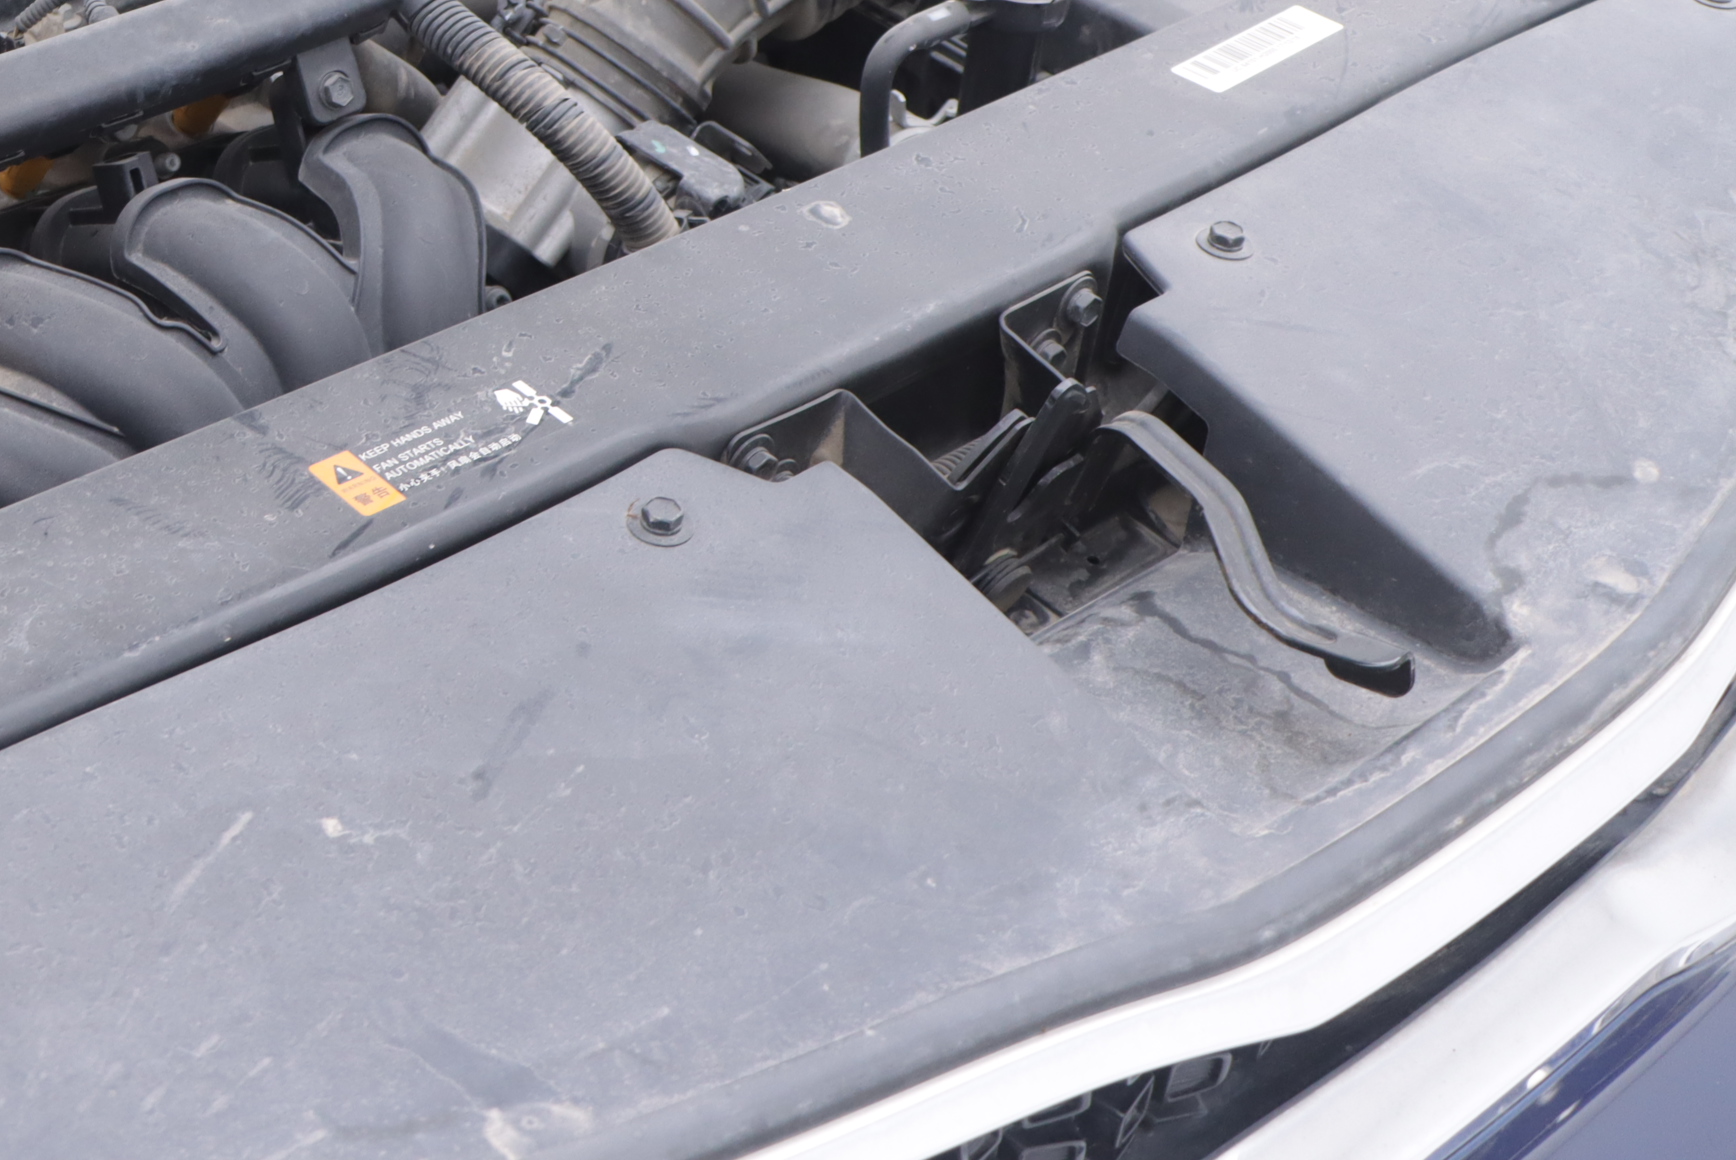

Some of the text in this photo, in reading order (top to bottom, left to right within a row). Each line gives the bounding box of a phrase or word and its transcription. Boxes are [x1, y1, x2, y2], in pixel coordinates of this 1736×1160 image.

[358, 411, 464, 461] KEEP HANDS AWAY
[372, 437, 444, 473] FAN STARTS
[384, 435, 476, 480] AUTOMATICALLY
